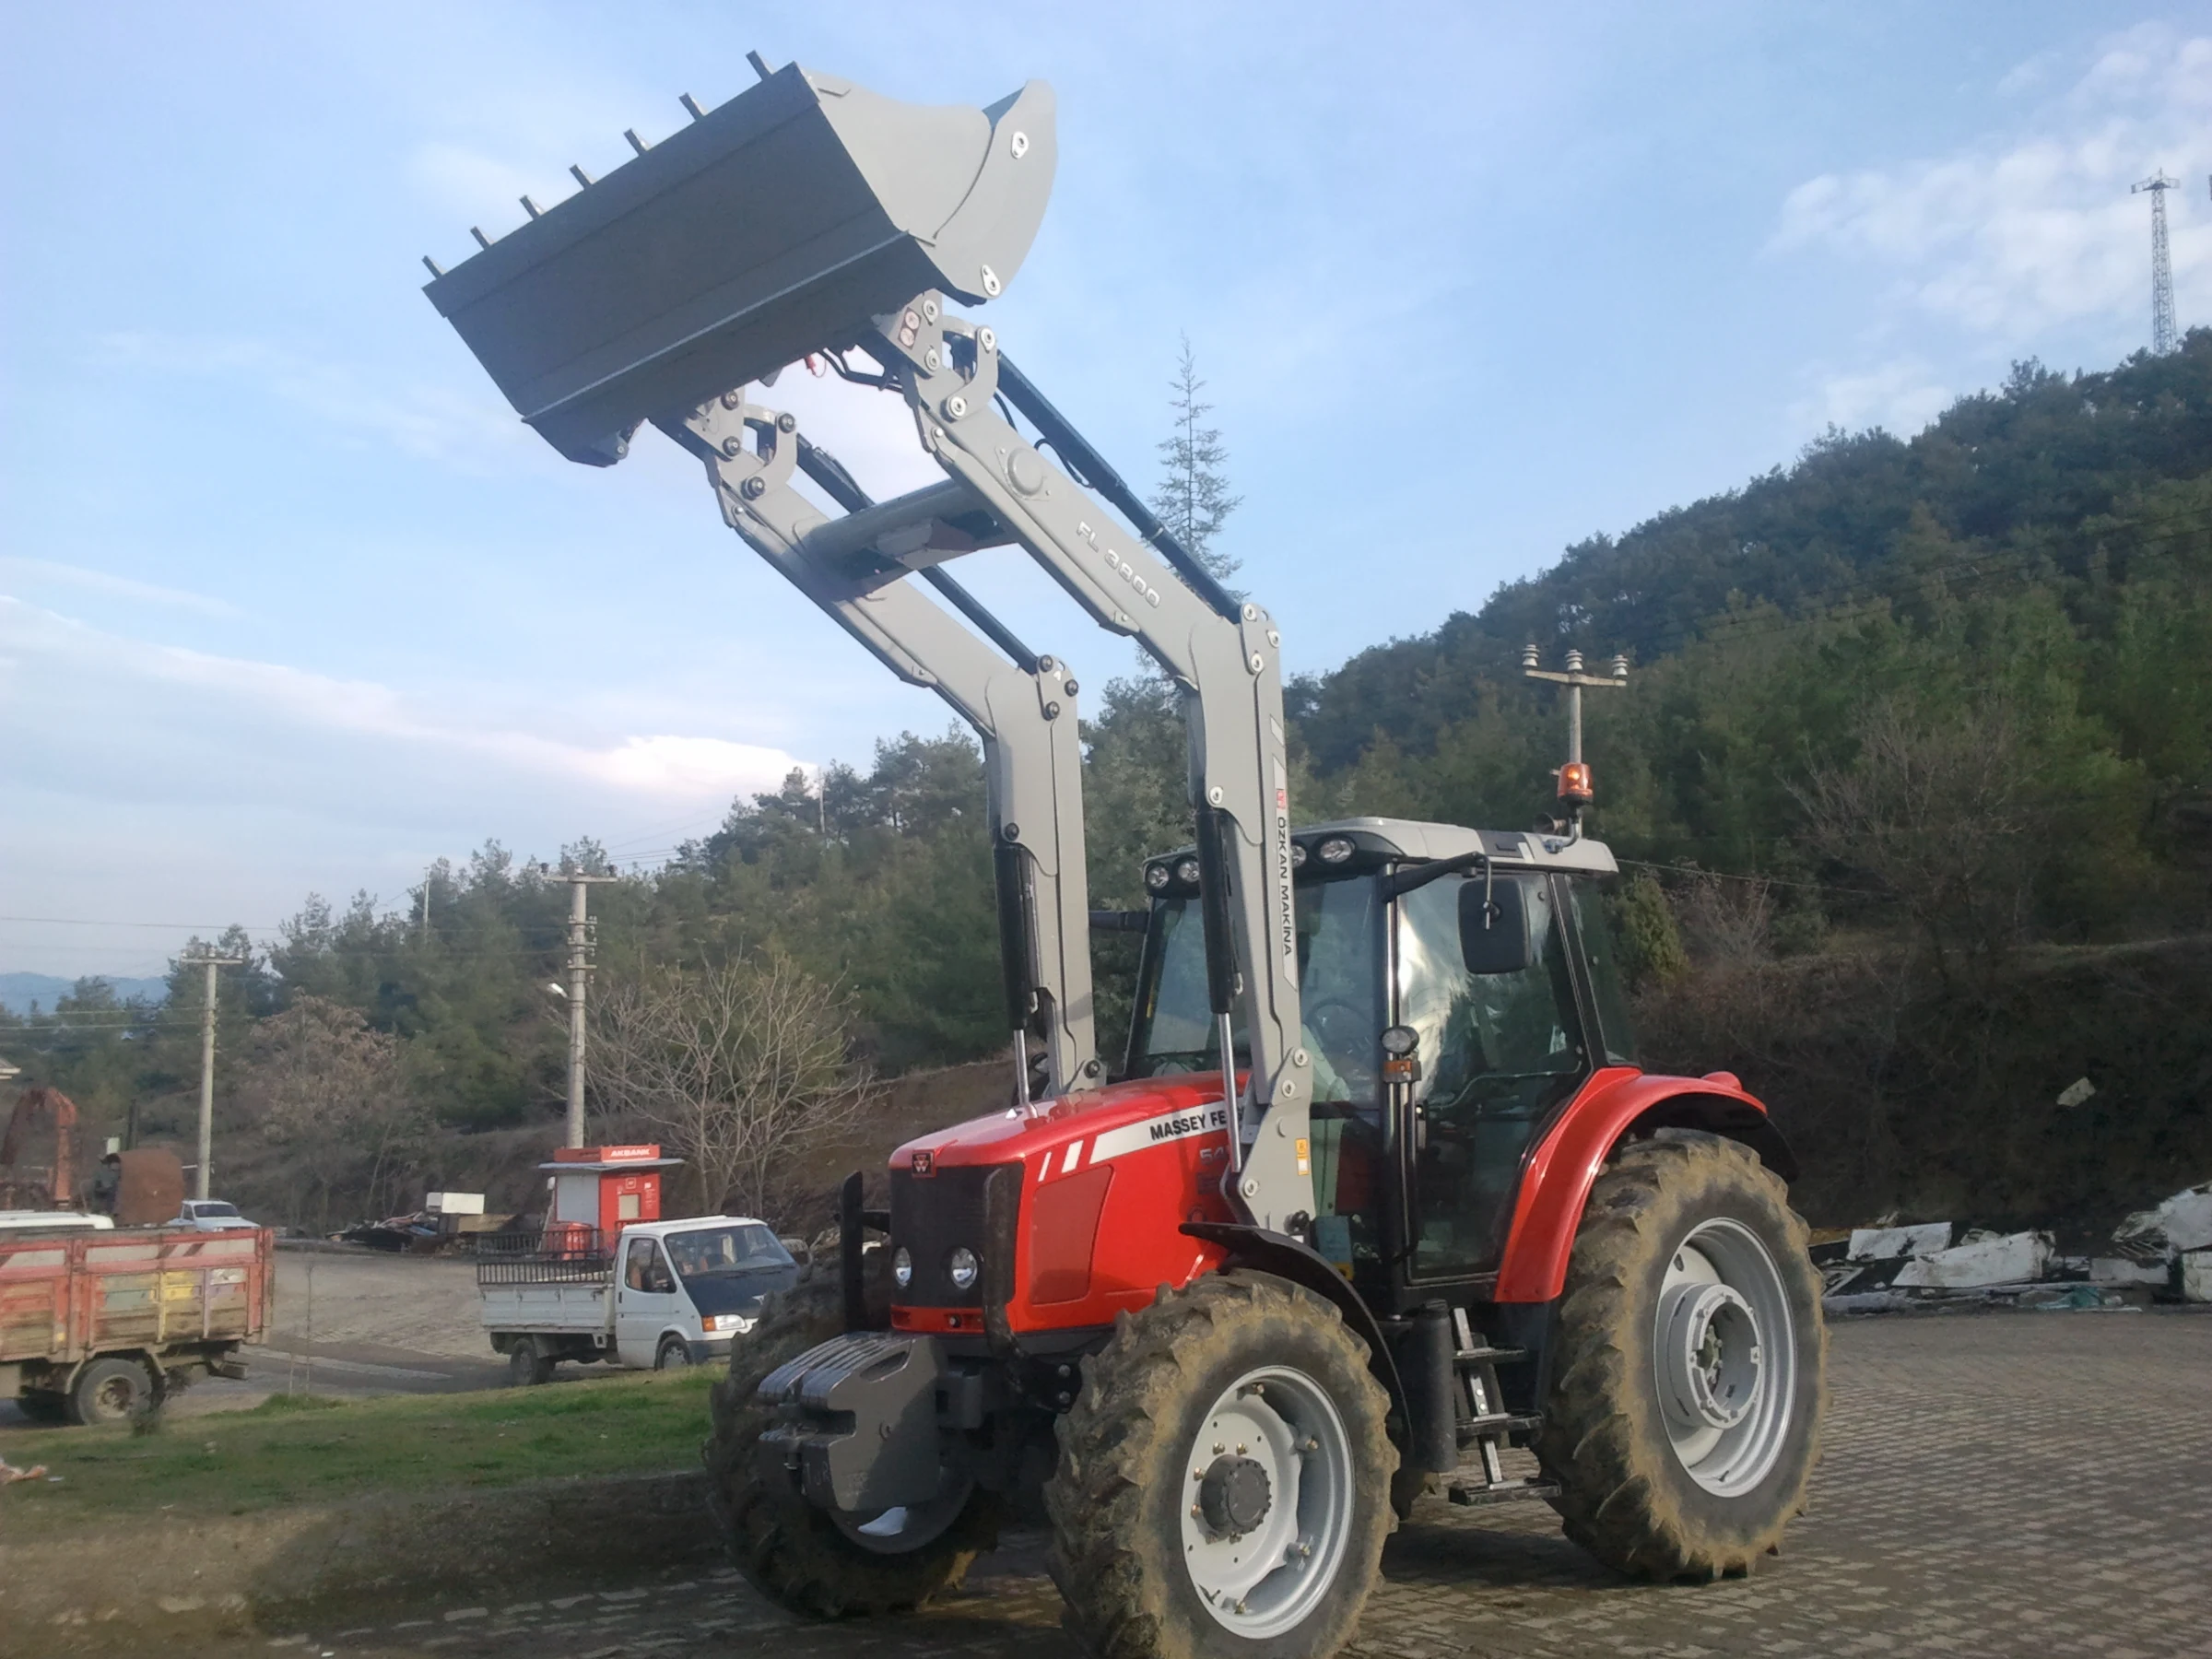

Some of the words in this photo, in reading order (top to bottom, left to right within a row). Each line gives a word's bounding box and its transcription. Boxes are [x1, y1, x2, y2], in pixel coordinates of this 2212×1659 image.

[1077, 521, 1099, 553] FL
[1104, 548, 1160, 608] 3800
[1277, 817, 1288, 879] ÖZKAN
[1281, 885, 1294, 956] MAKİNA
[610, 1148, 650, 1158] AKBANK
[1149, 1113, 1206, 1141] MASSEY
